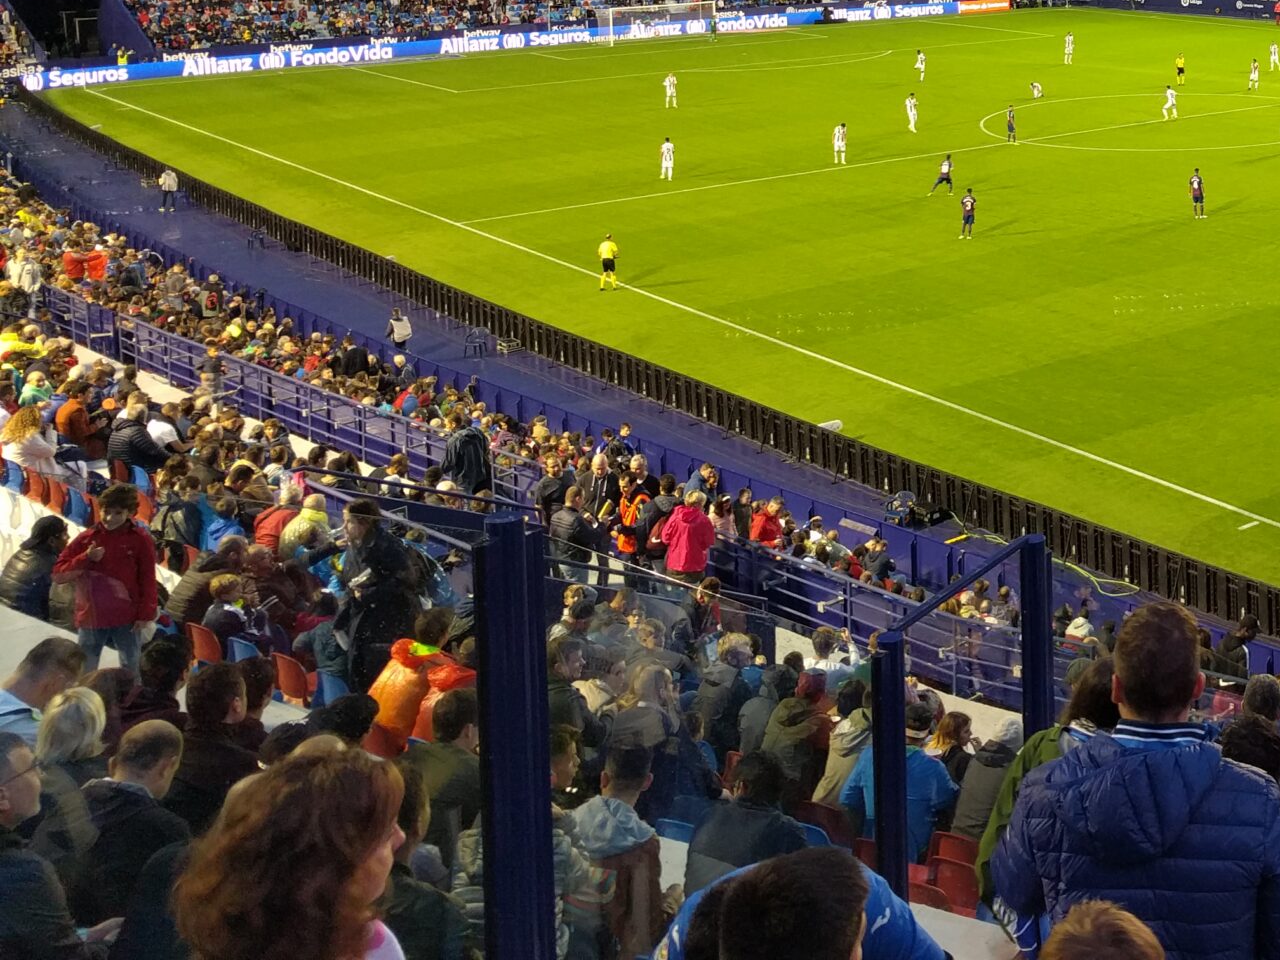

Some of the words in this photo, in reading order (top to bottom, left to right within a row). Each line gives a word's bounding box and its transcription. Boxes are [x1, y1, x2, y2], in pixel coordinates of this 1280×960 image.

[894, 5, 944, 18] Seguros
[713, 16, 787, 34] ondoVida
[440, 36, 499, 54] Allianz
[529, 31, 590, 46] Seguros
[182, 54, 253, 77] Allianz
[290, 45, 393, 67] FondoVida
[49, 68, 129, 87] Seguros
[965, 201, 972, 211] 3
